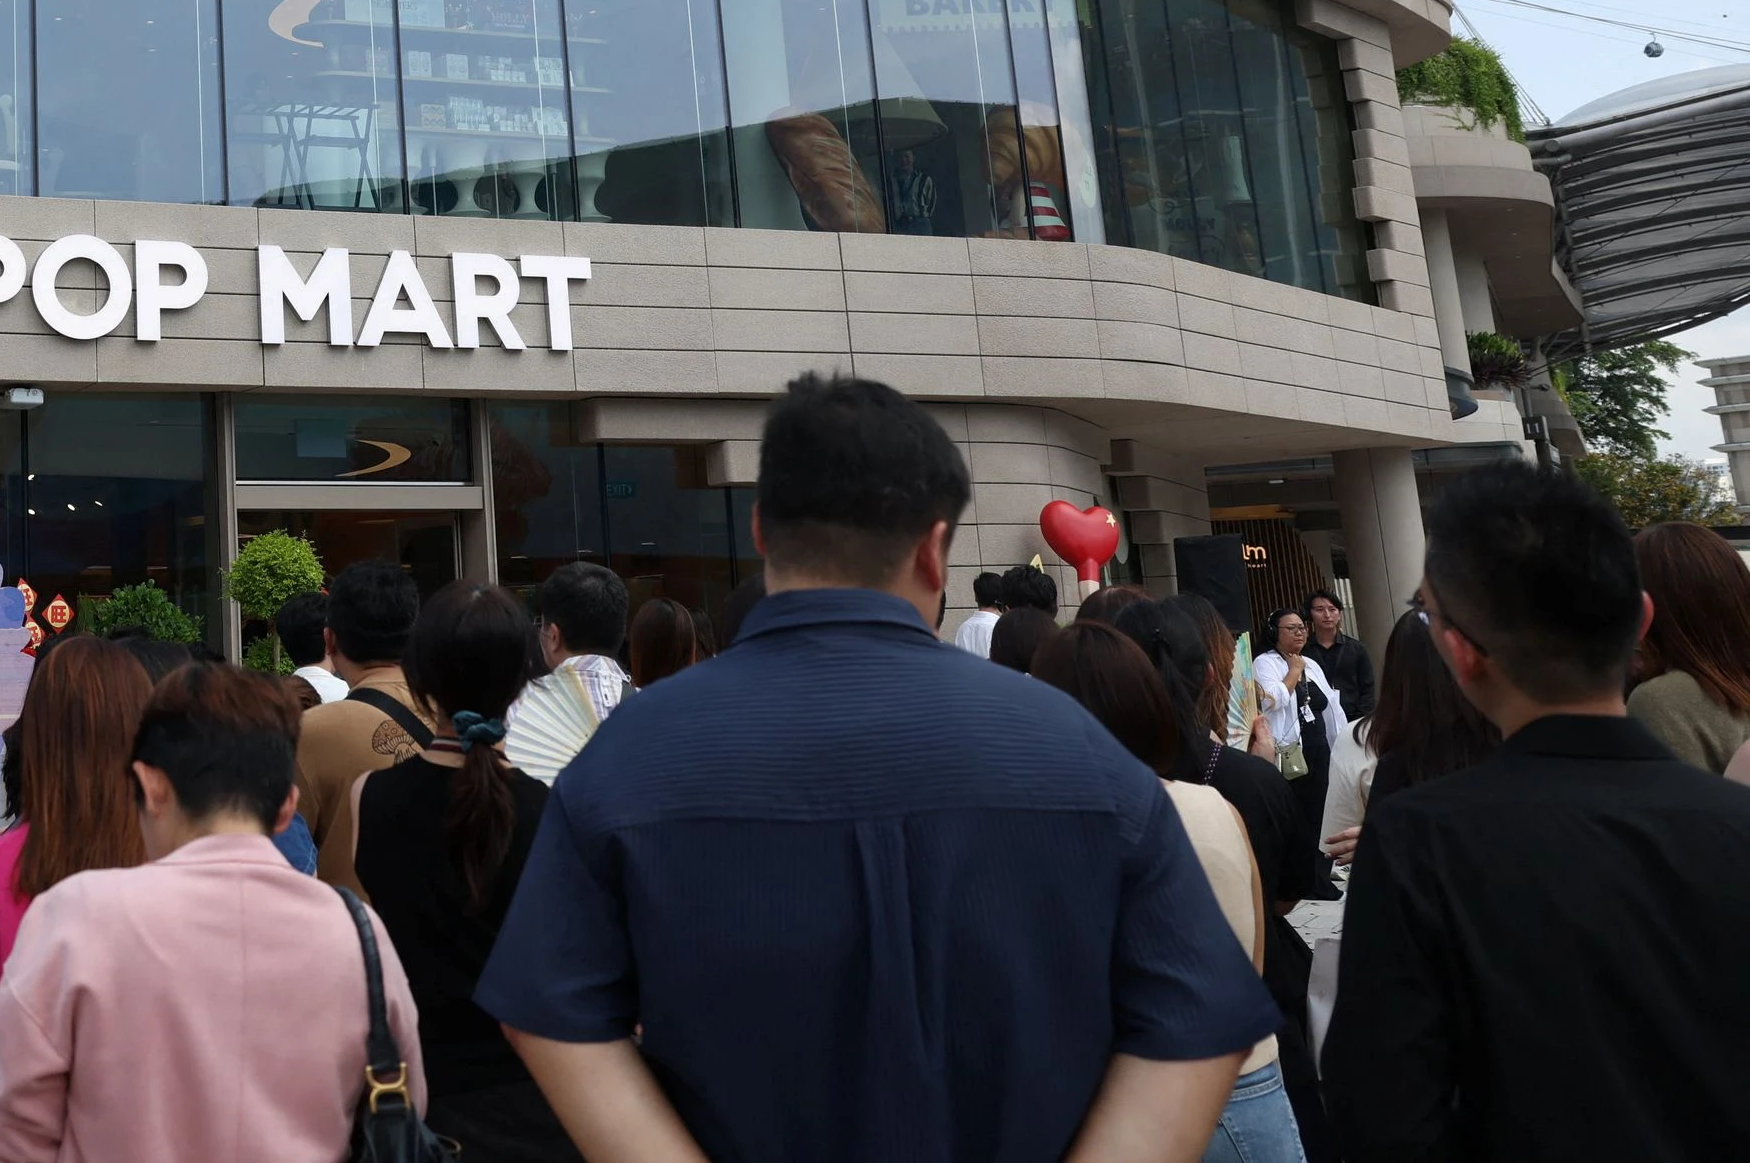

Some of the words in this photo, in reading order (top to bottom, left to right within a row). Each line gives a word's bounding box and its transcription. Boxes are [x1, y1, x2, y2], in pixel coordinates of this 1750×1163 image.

[257, 244, 592, 352] MART
[605, 483, 627, 496] EXIT
[50, 605, 67, 624] 旺
